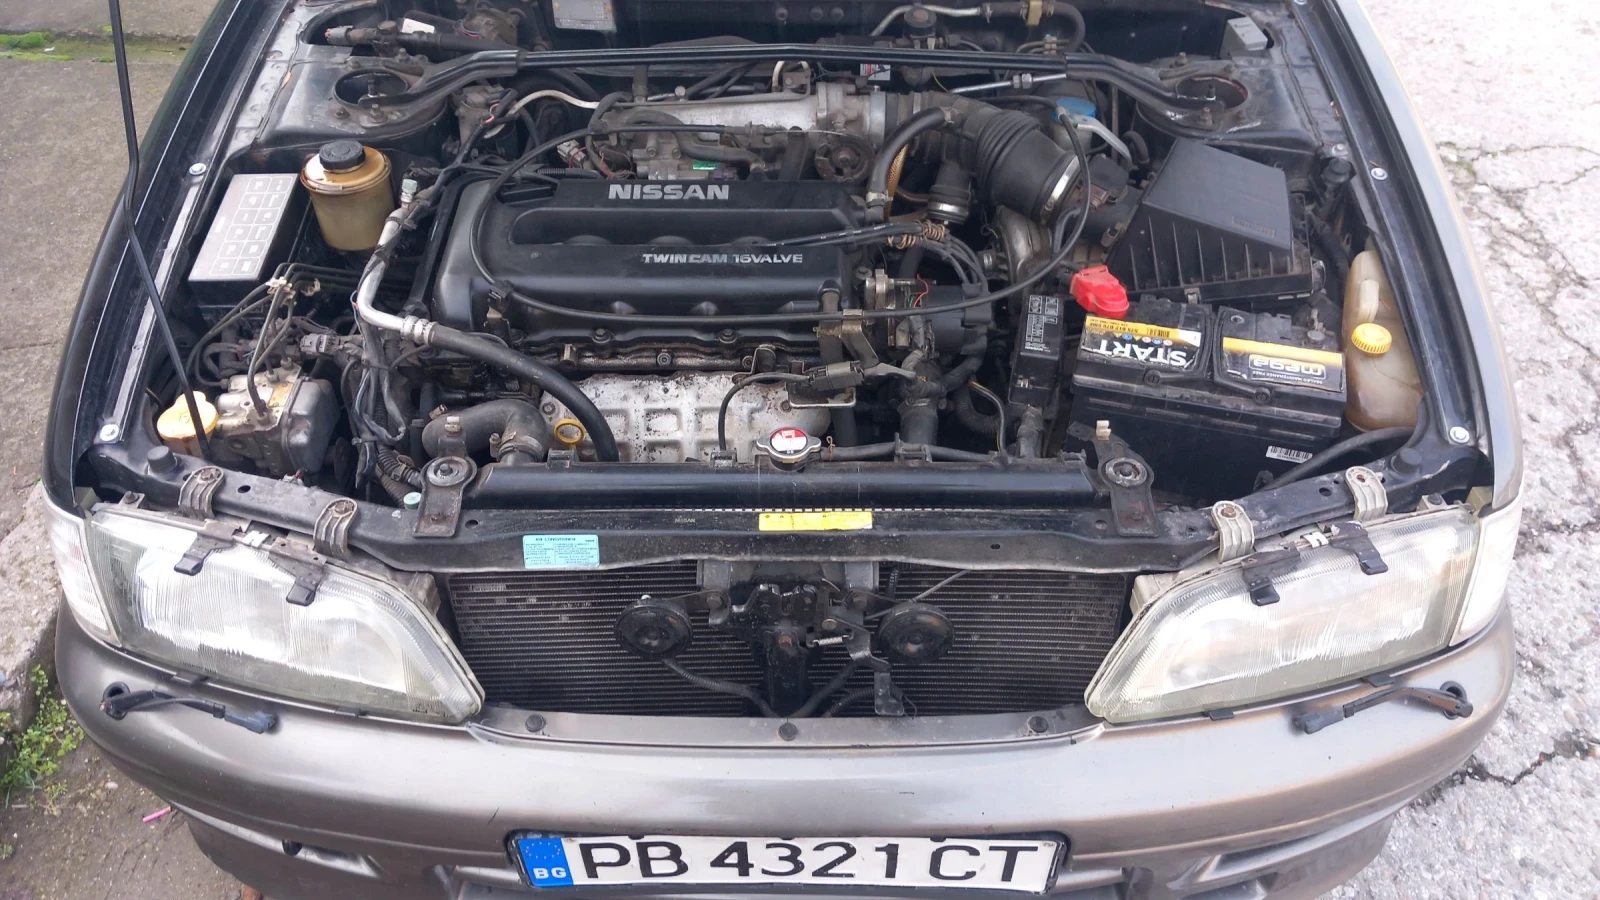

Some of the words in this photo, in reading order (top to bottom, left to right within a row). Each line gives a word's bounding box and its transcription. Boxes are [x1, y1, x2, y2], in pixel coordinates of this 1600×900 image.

[608, 184, 730, 200] NISSAN
[732, 253, 803, 264] 16VALVE
[1093, 339, 1187, 367] START
[1253, 358, 1323, 376] mega
[1266, 372, 1302, 382] MAINTENANCE
[578, 841, 689, 879] PB
[710, 841, 899, 879] 4321
[929, 845, 1039, 882] CT
[533, 867, 567, 879] BG
